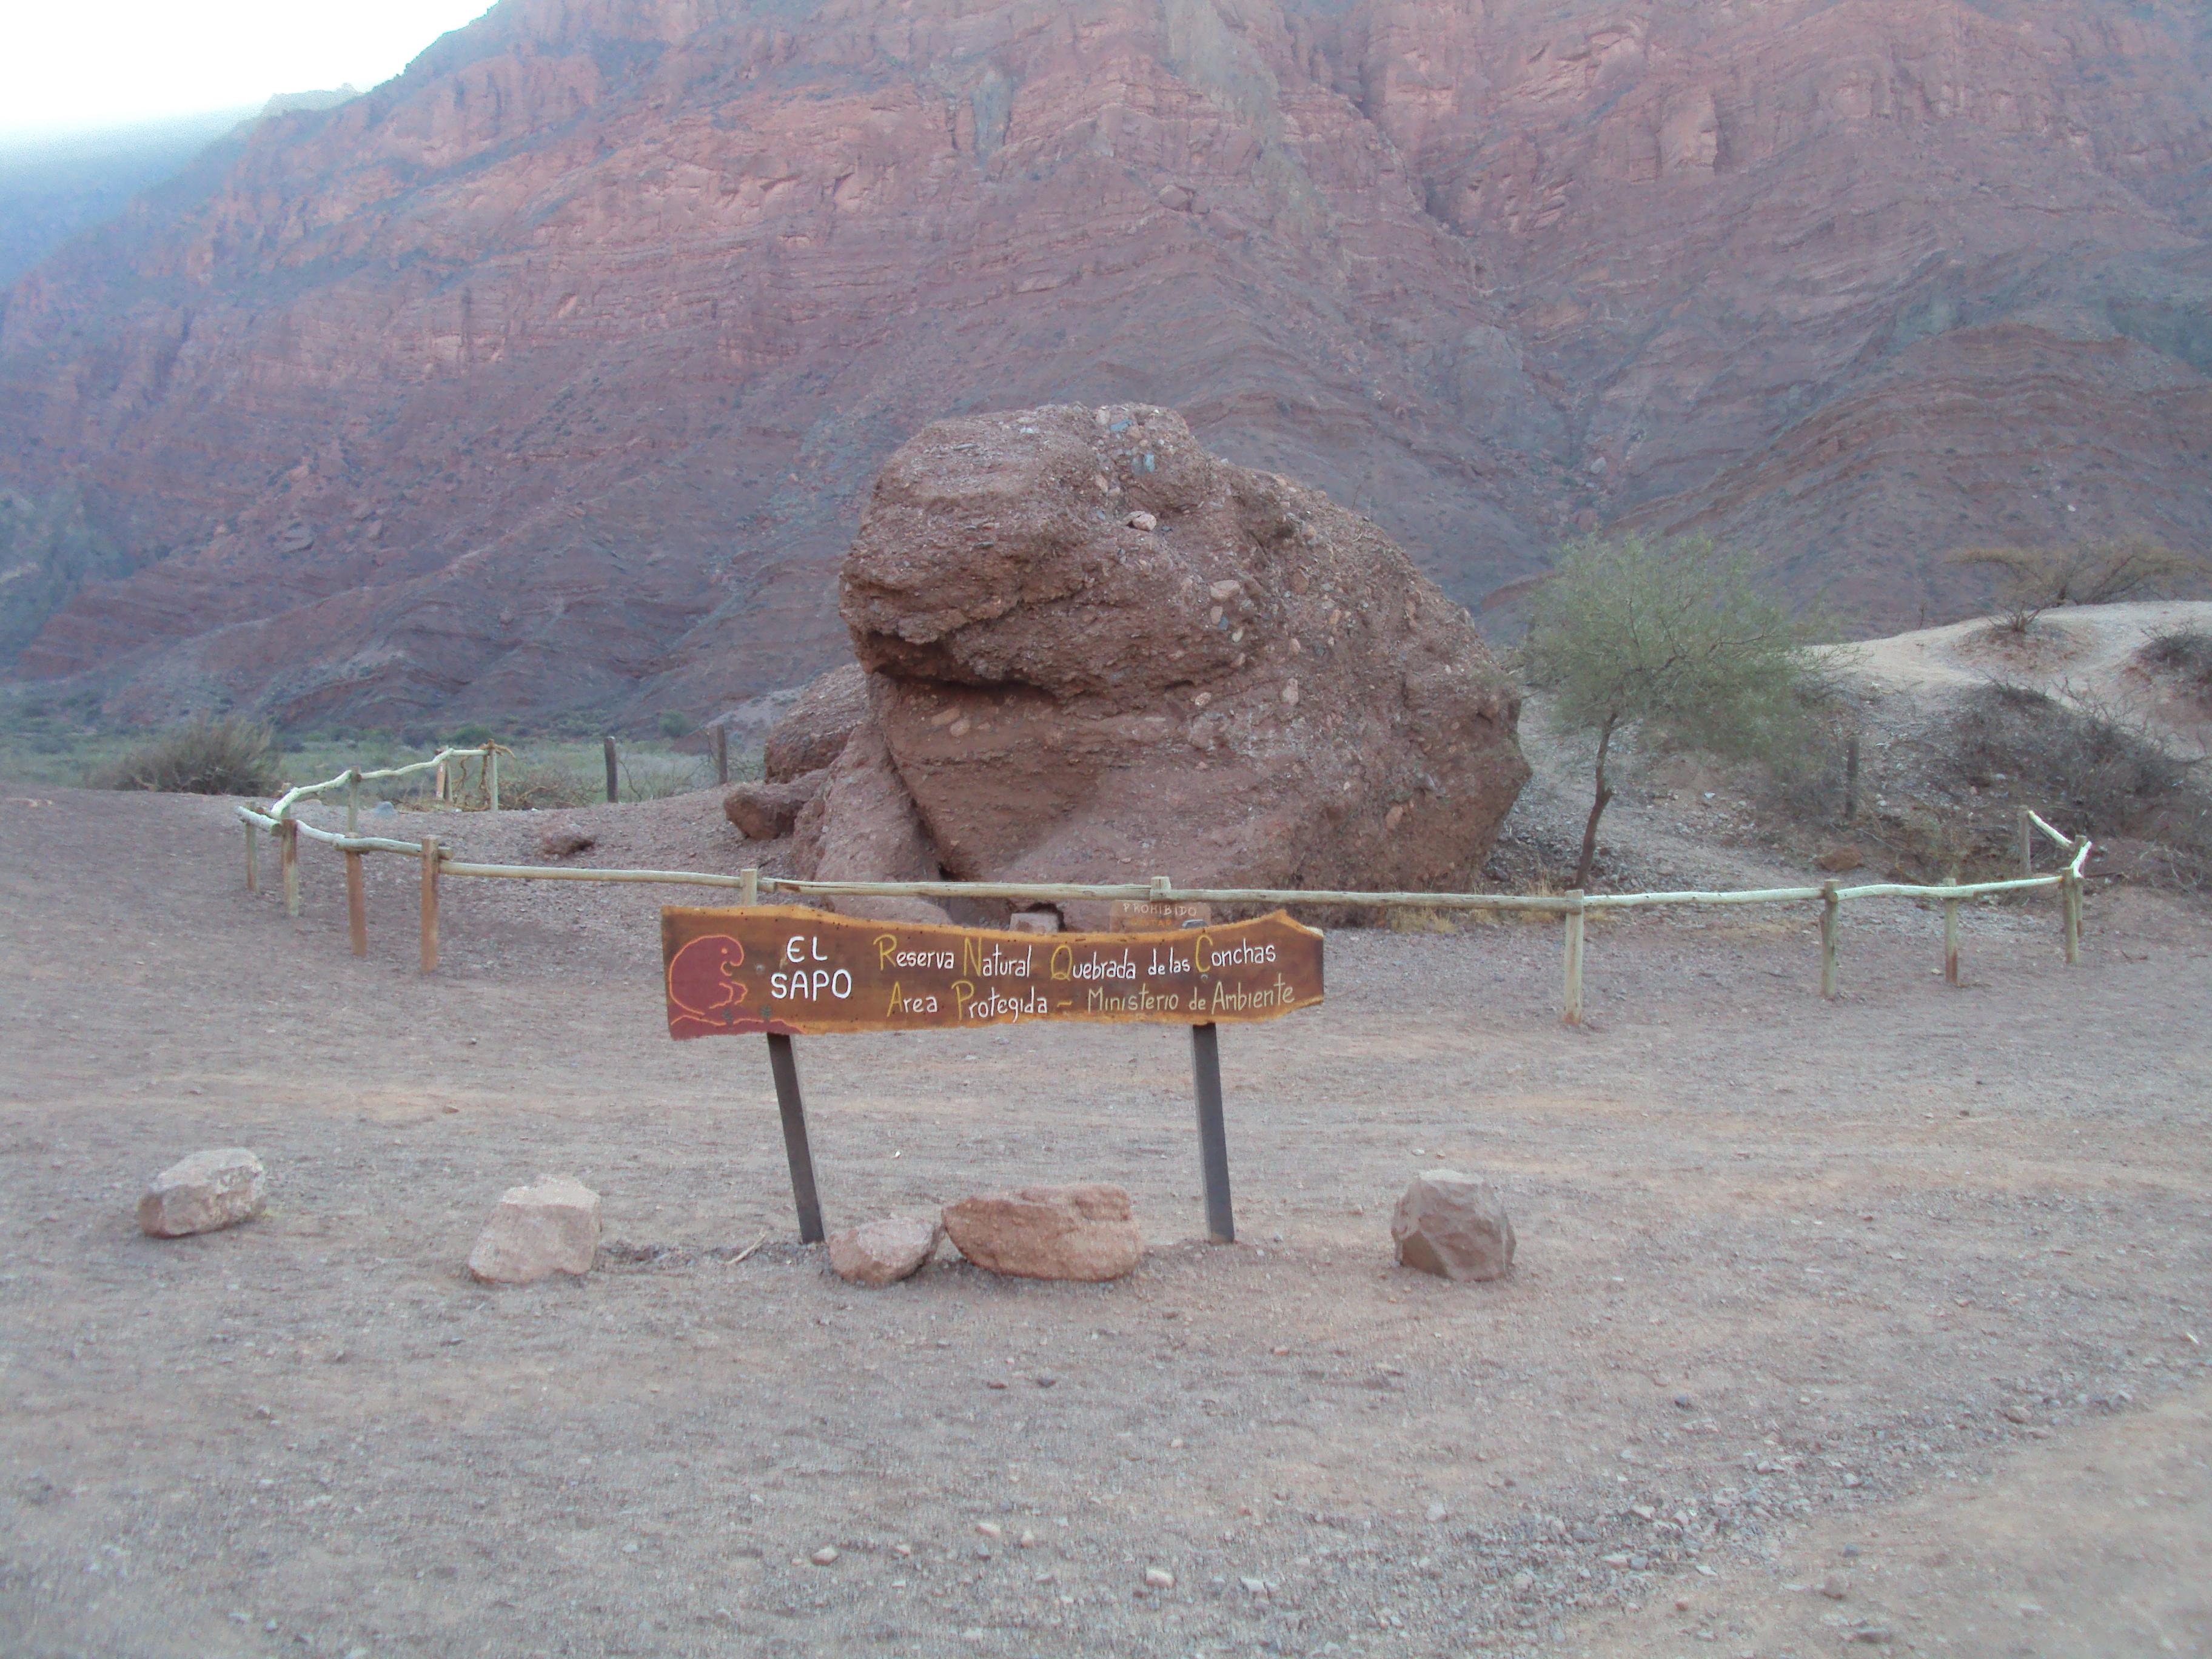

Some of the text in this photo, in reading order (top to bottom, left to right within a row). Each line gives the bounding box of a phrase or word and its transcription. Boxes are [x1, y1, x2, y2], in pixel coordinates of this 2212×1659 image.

[1123, 903, 1196, 916] PROHIBIDO
[787, 936, 828, 962] EL
[873, 934, 1276, 981] Reserva Natural Quebrada de las Conchas
[771, 970, 852, 1001] SAPO
[887, 981, 937, 1017] Area
[951, 980, 1047, 1023] Protegida
[1088, 983, 1179, 1013] Ministerio
[1188, 987, 1206, 1011] de
[1212, 973, 1295, 1014] Ambiente
